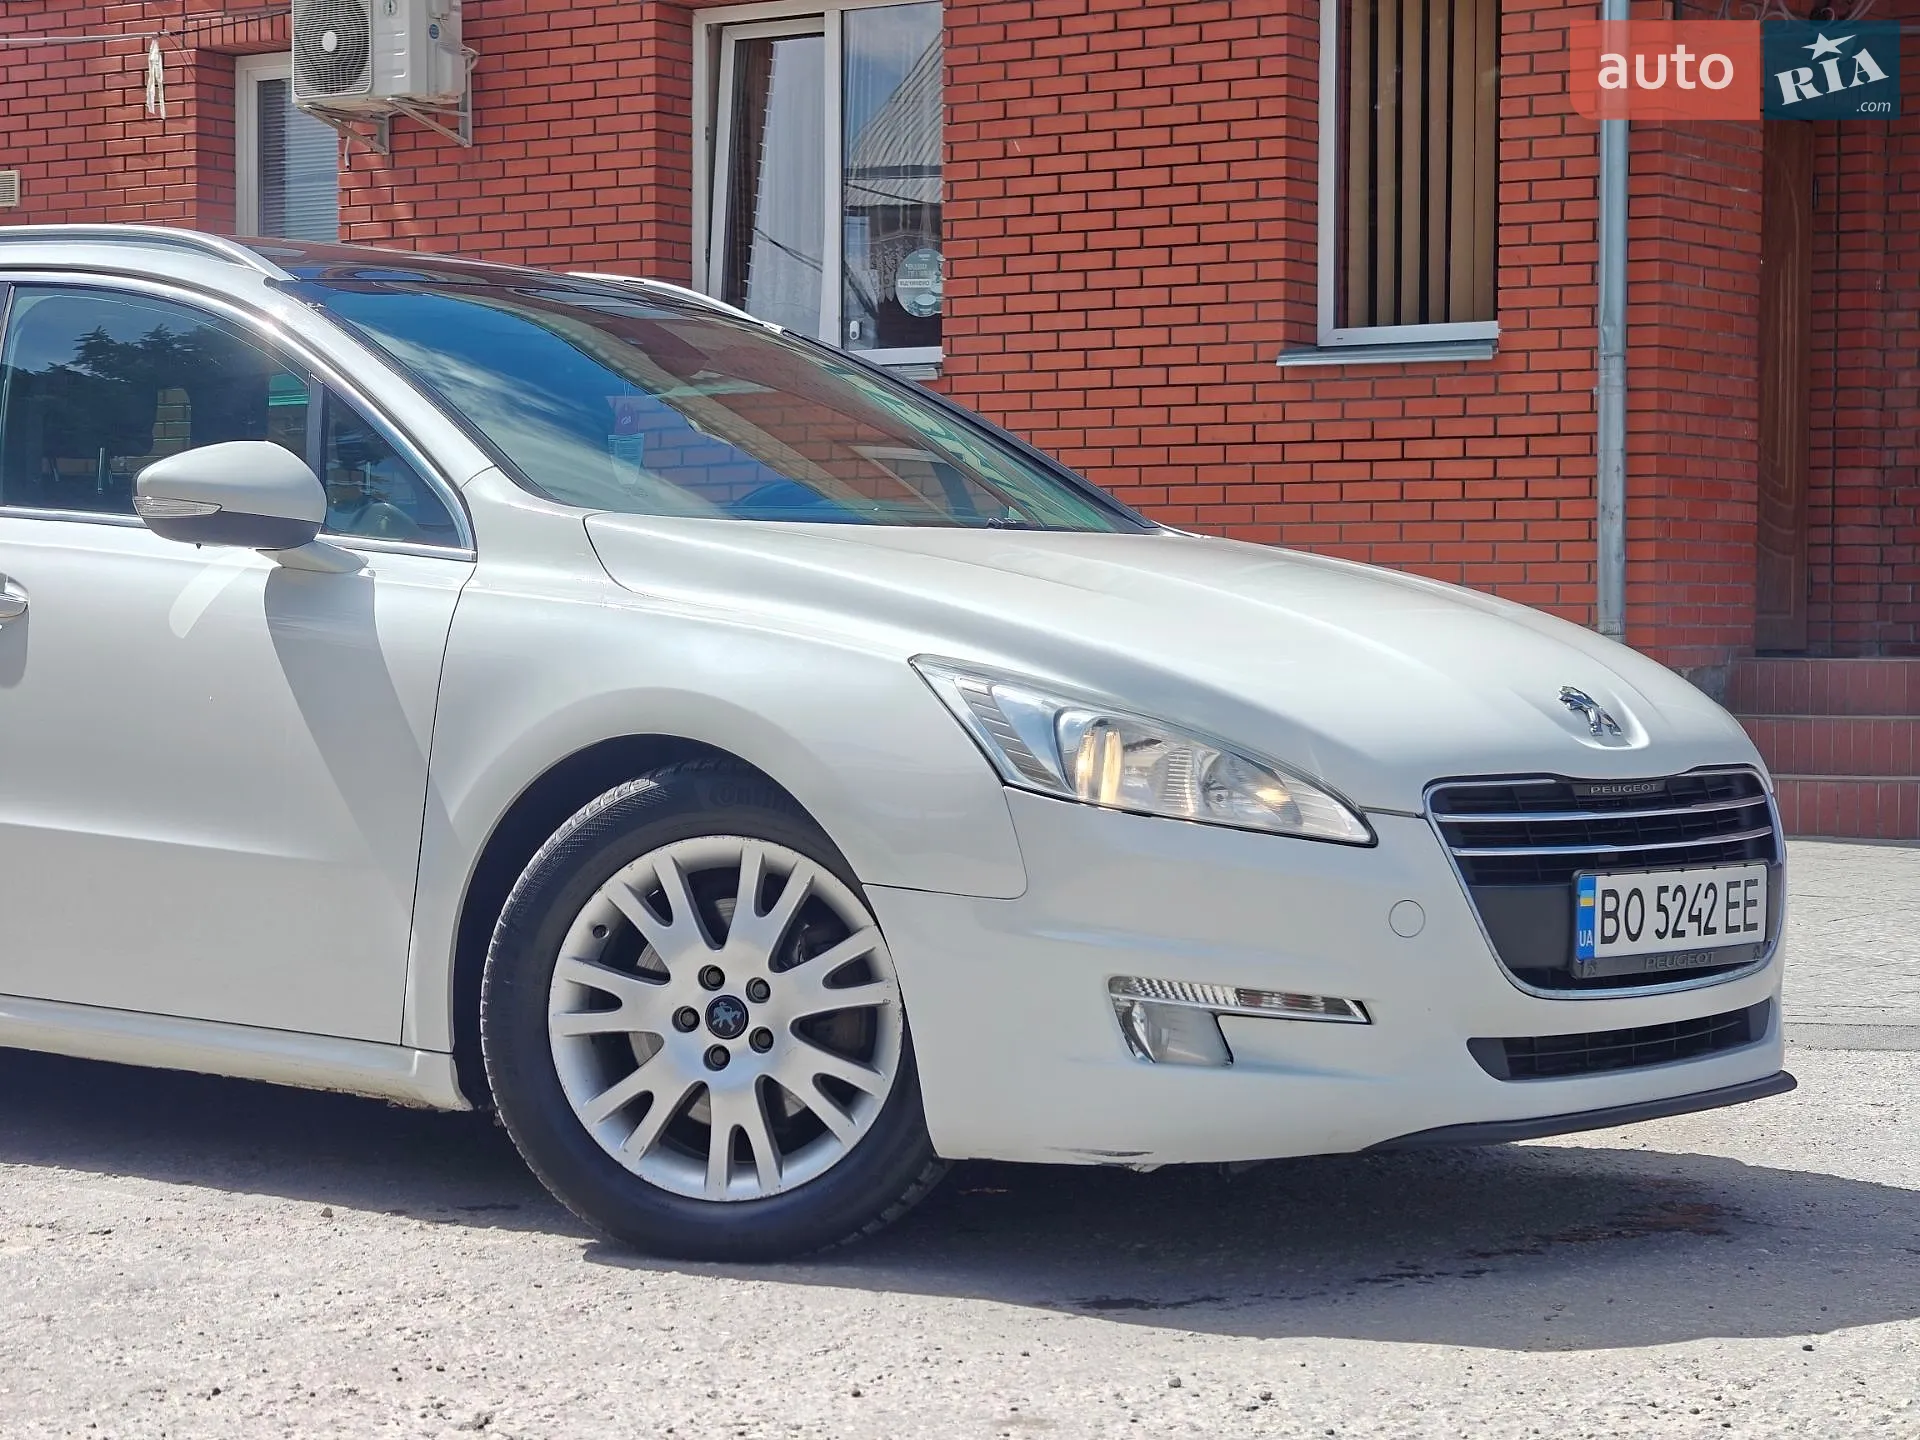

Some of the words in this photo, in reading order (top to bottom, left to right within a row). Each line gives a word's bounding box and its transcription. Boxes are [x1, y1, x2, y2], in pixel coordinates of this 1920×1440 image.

[1590, 783, 1657, 794] PEUGEOT
[1600, 888, 1645, 945] BO
[1655, 882, 1718, 940] 5242
[1725, 878, 1759, 934] EE
[1579, 930, 1593, 947] UA
[1643, 951, 1715, 971] PEUGEOT
